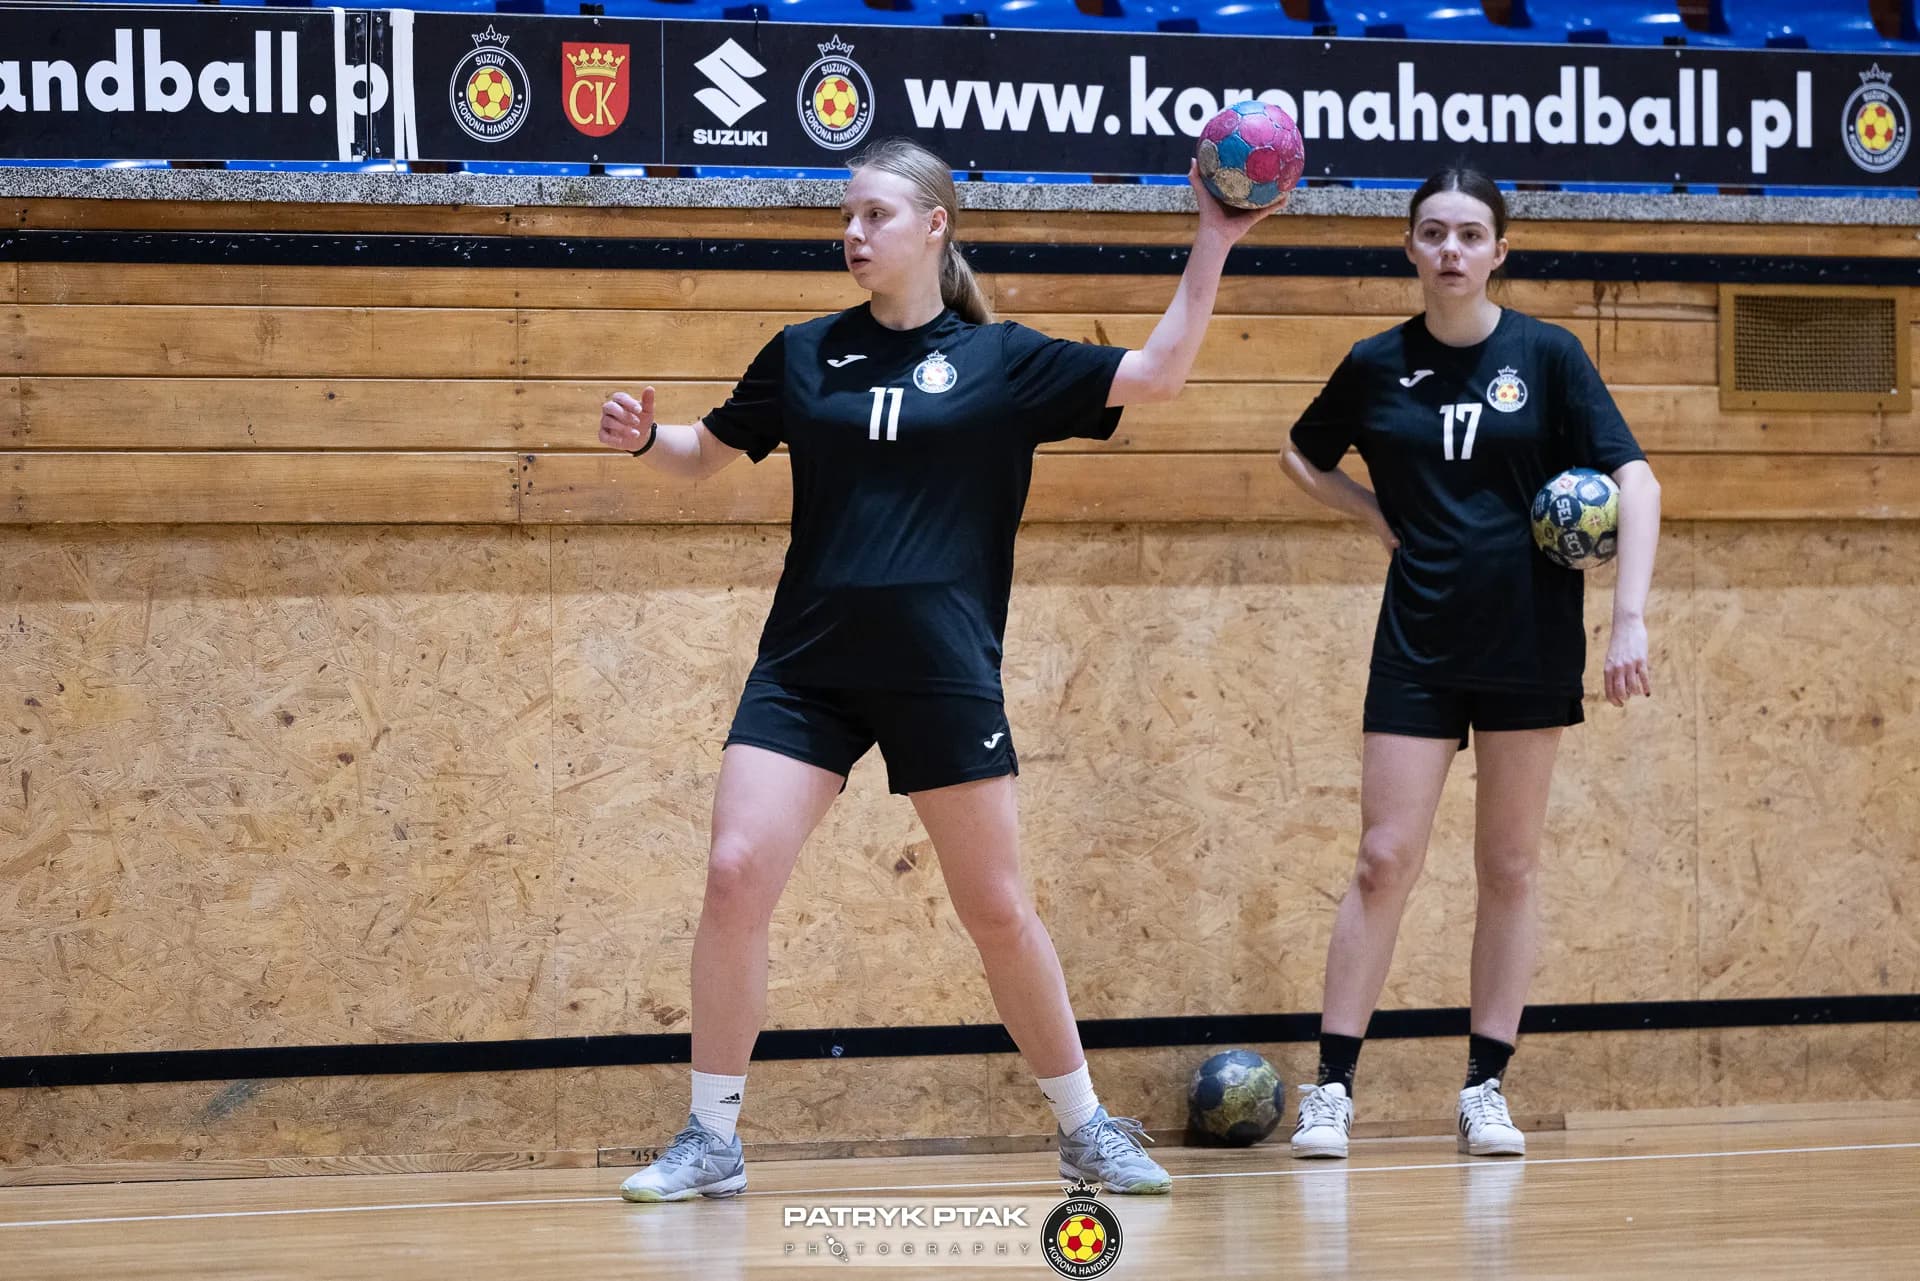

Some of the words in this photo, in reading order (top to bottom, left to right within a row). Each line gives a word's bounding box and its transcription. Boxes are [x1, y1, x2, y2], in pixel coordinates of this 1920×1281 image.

[475, 54, 506, 67] SUZUKI
[821, 63, 851, 76] SUZUKI
[457, 101, 485, 134] KORONA
[486, 103, 523, 135] HANDBALL
[569, 80, 617, 125] CK
[693, 129, 768, 146] SUZUKI
[805, 109, 832, 141] KORONA
[833, 111, 868, 142] HANDBALL
[869, 387, 905, 441] 11
[1439, 403, 1482, 460] 17
